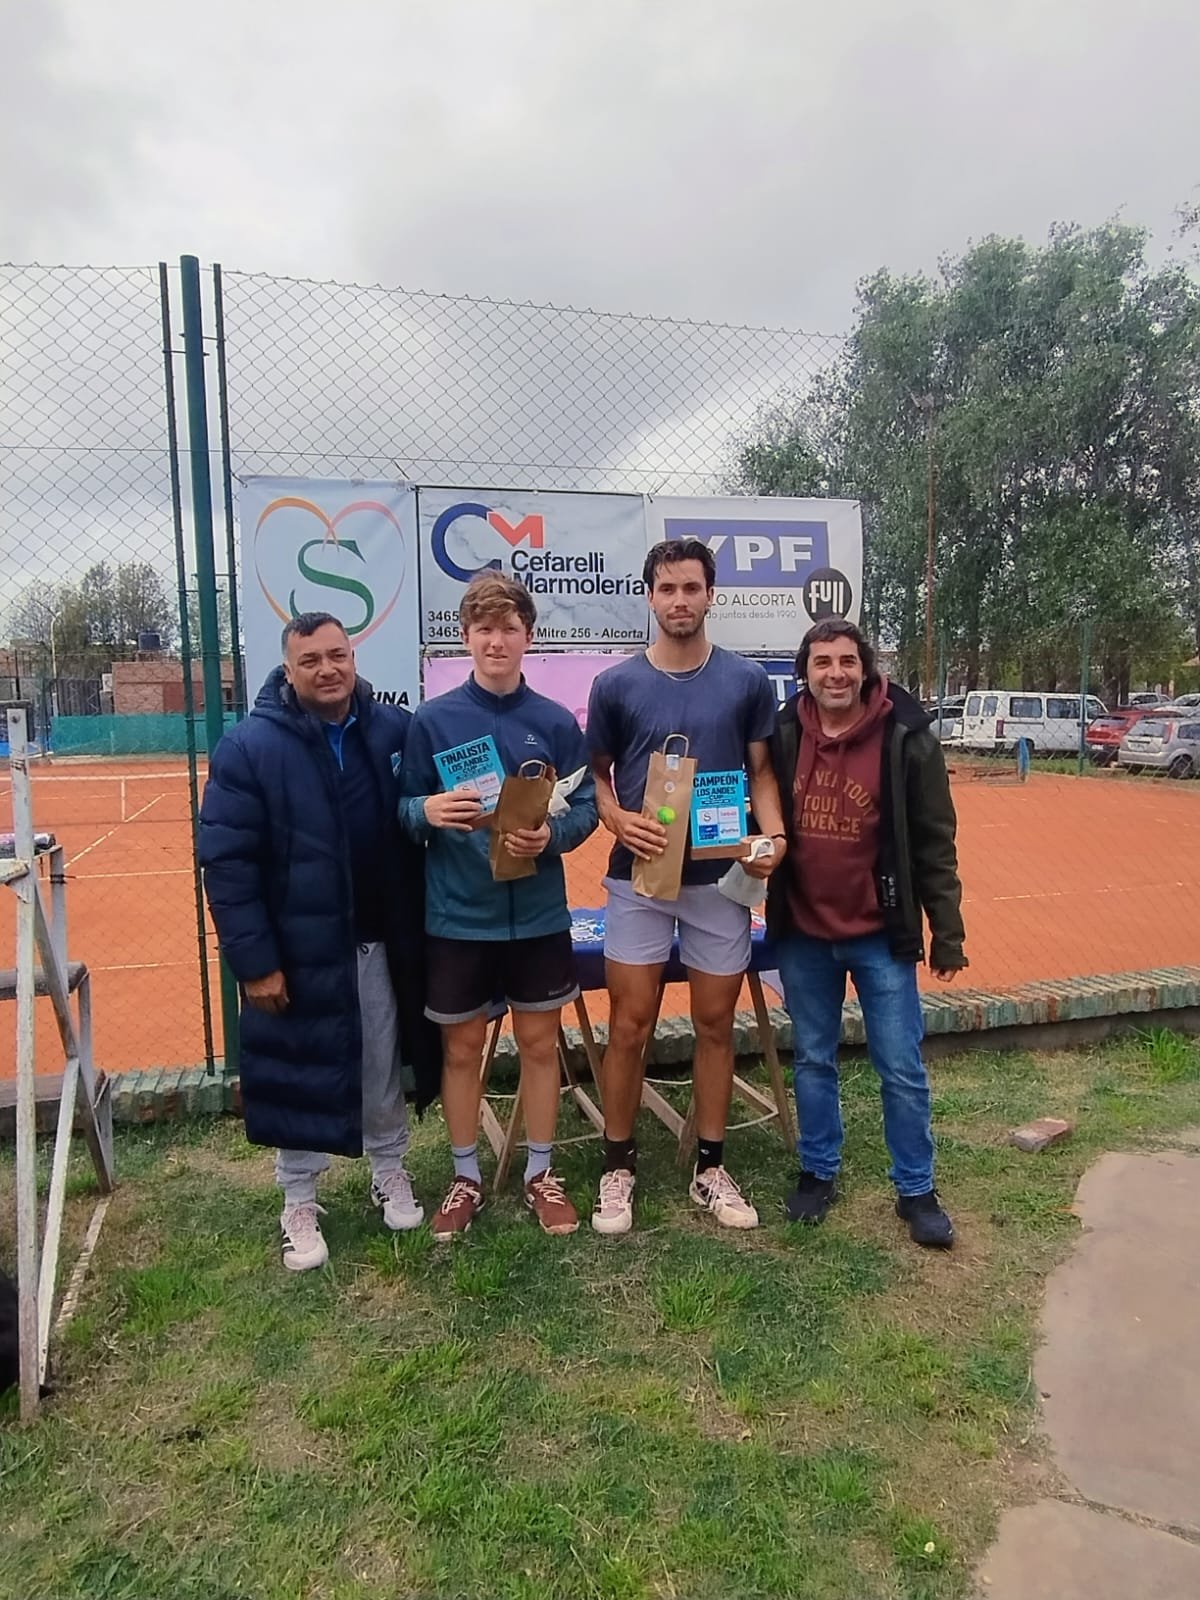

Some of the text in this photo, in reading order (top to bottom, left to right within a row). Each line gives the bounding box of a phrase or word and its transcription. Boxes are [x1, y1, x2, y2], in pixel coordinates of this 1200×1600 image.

[510, 550, 604, 573] Cefarelli
[513, 572, 645, 595] Marmolería
[731, 593, 796, 606] ALCORTA
[808, 580, 844, 614] full
[428, 611, 459, 622] 3465
[719, 610, 747, 621] juntos
[748, 610, 774, 619] desde
[777, 610, 797, 619] 1990
[428, 626, 459, 638] 3465
[536, 627, 567, 638] Mitre
[570, 628, 591, 638] 256
[601, 628, 643, 639] Alcorta
[440, 742, 490, 767] FINALISTA
[448, 754, 489, 774] LOS ANDES
[693, 773, 739, 788] CAMPEÓN
[697, 787, 736, 797] LOS ANDES
